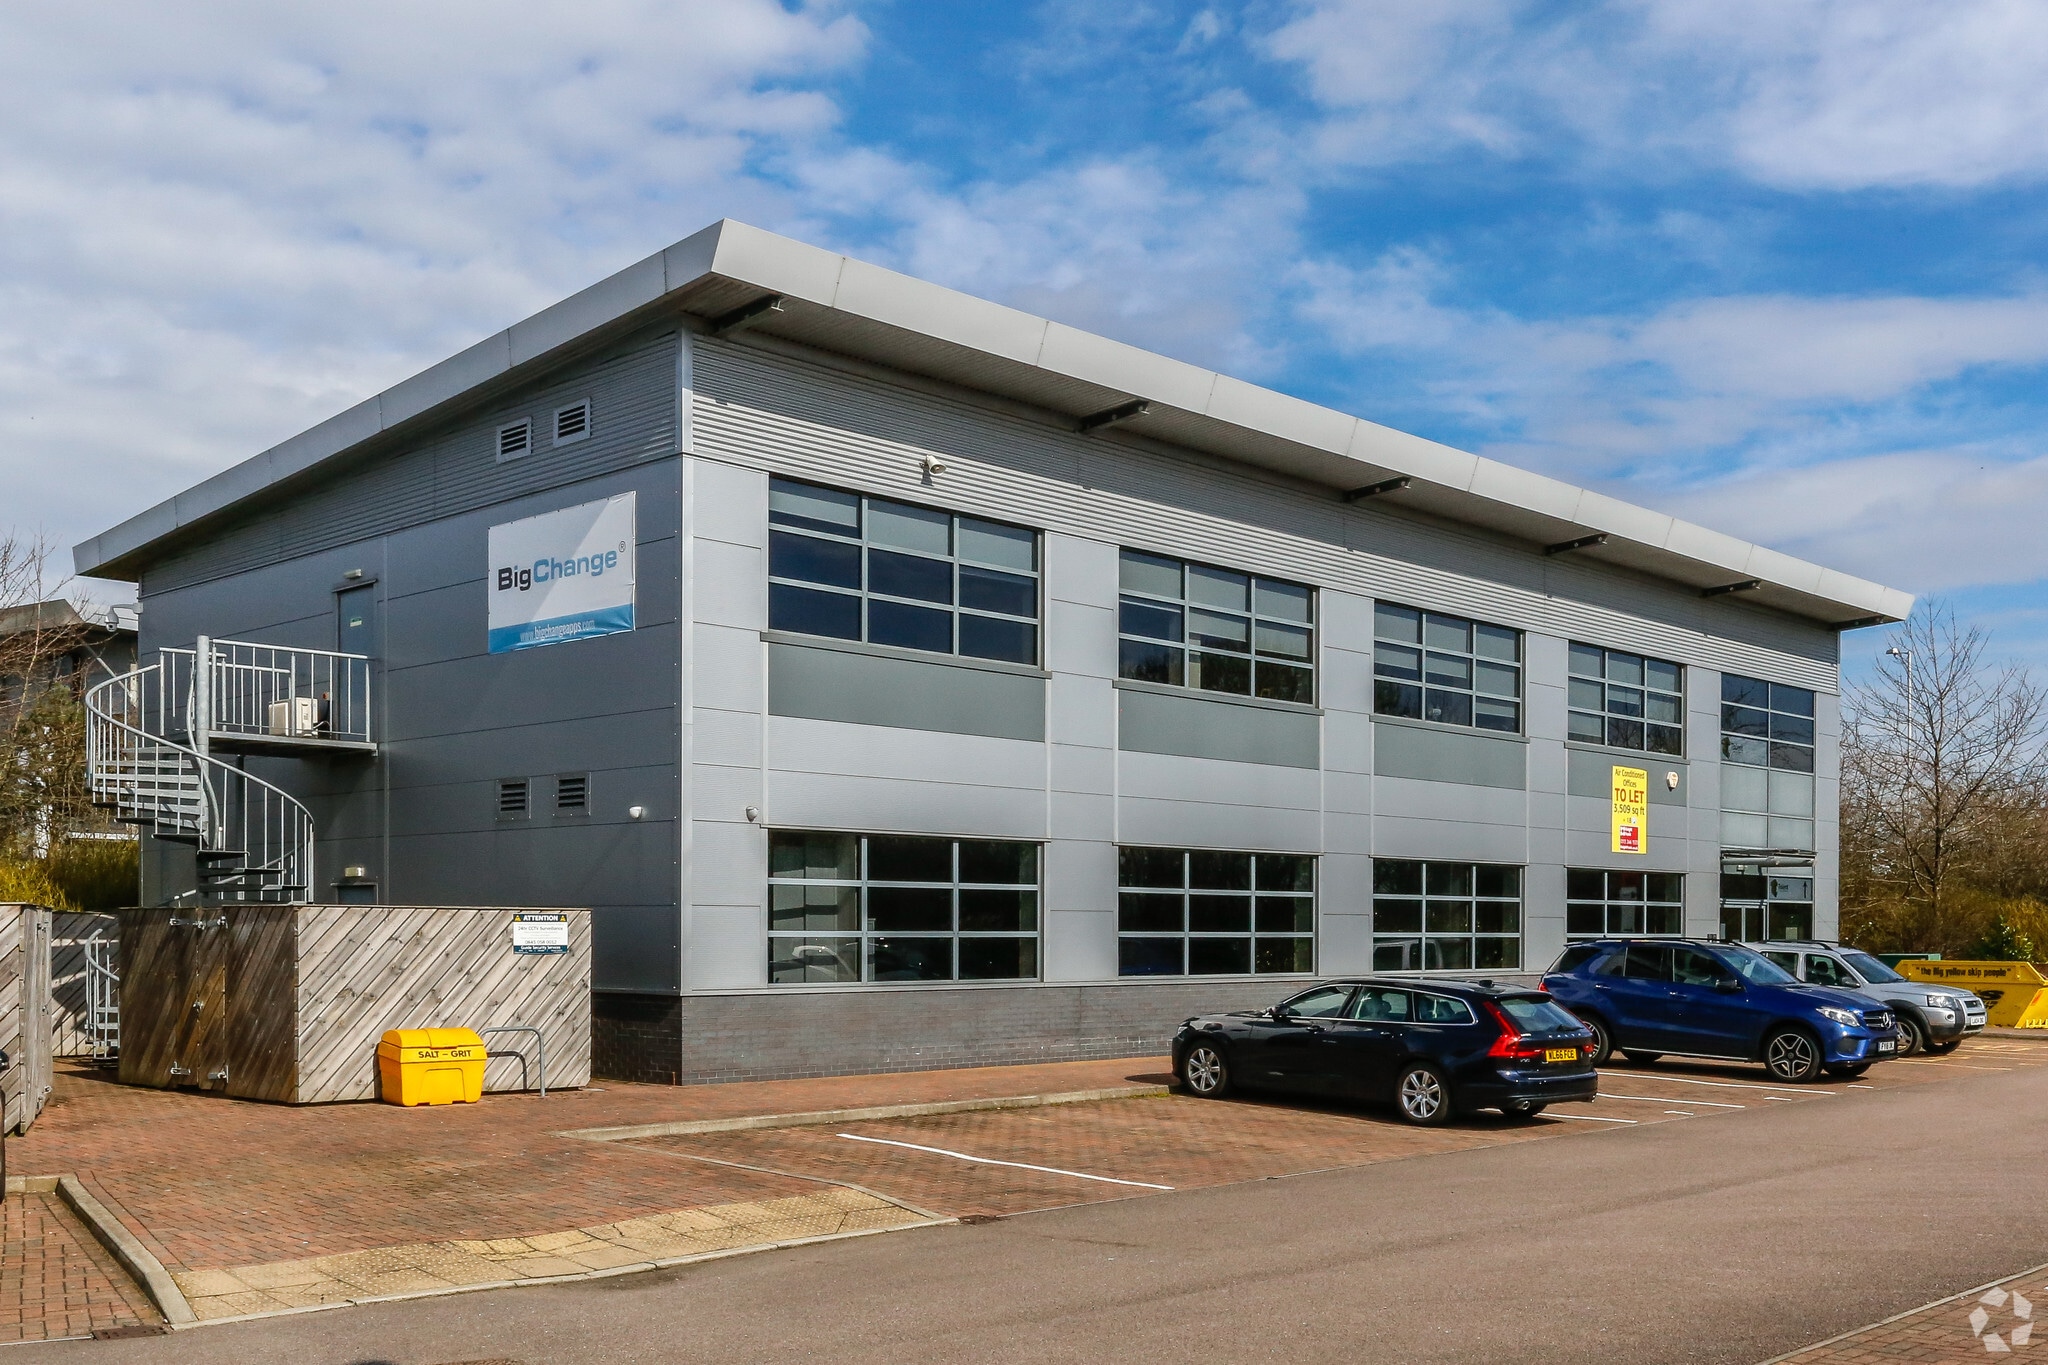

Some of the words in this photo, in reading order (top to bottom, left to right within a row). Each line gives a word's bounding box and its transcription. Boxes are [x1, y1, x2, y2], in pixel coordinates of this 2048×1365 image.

[498, 550, 617, 591] BigChange
[1623, 779, 1637, 788] Offices
[1614, 788, 1627, 802] TO
[1629, 789, 1645, 804] LET
[1614, 803, 1631, 814] 3,509
[1632, 807, 1639, 816] sq
[1640, 806, 1645, 815] ft
[1945, 967, 1966, 977] yellow
[1967, 968, 1982, 978] skip
[418, 1050, 440, 1058] SALT
